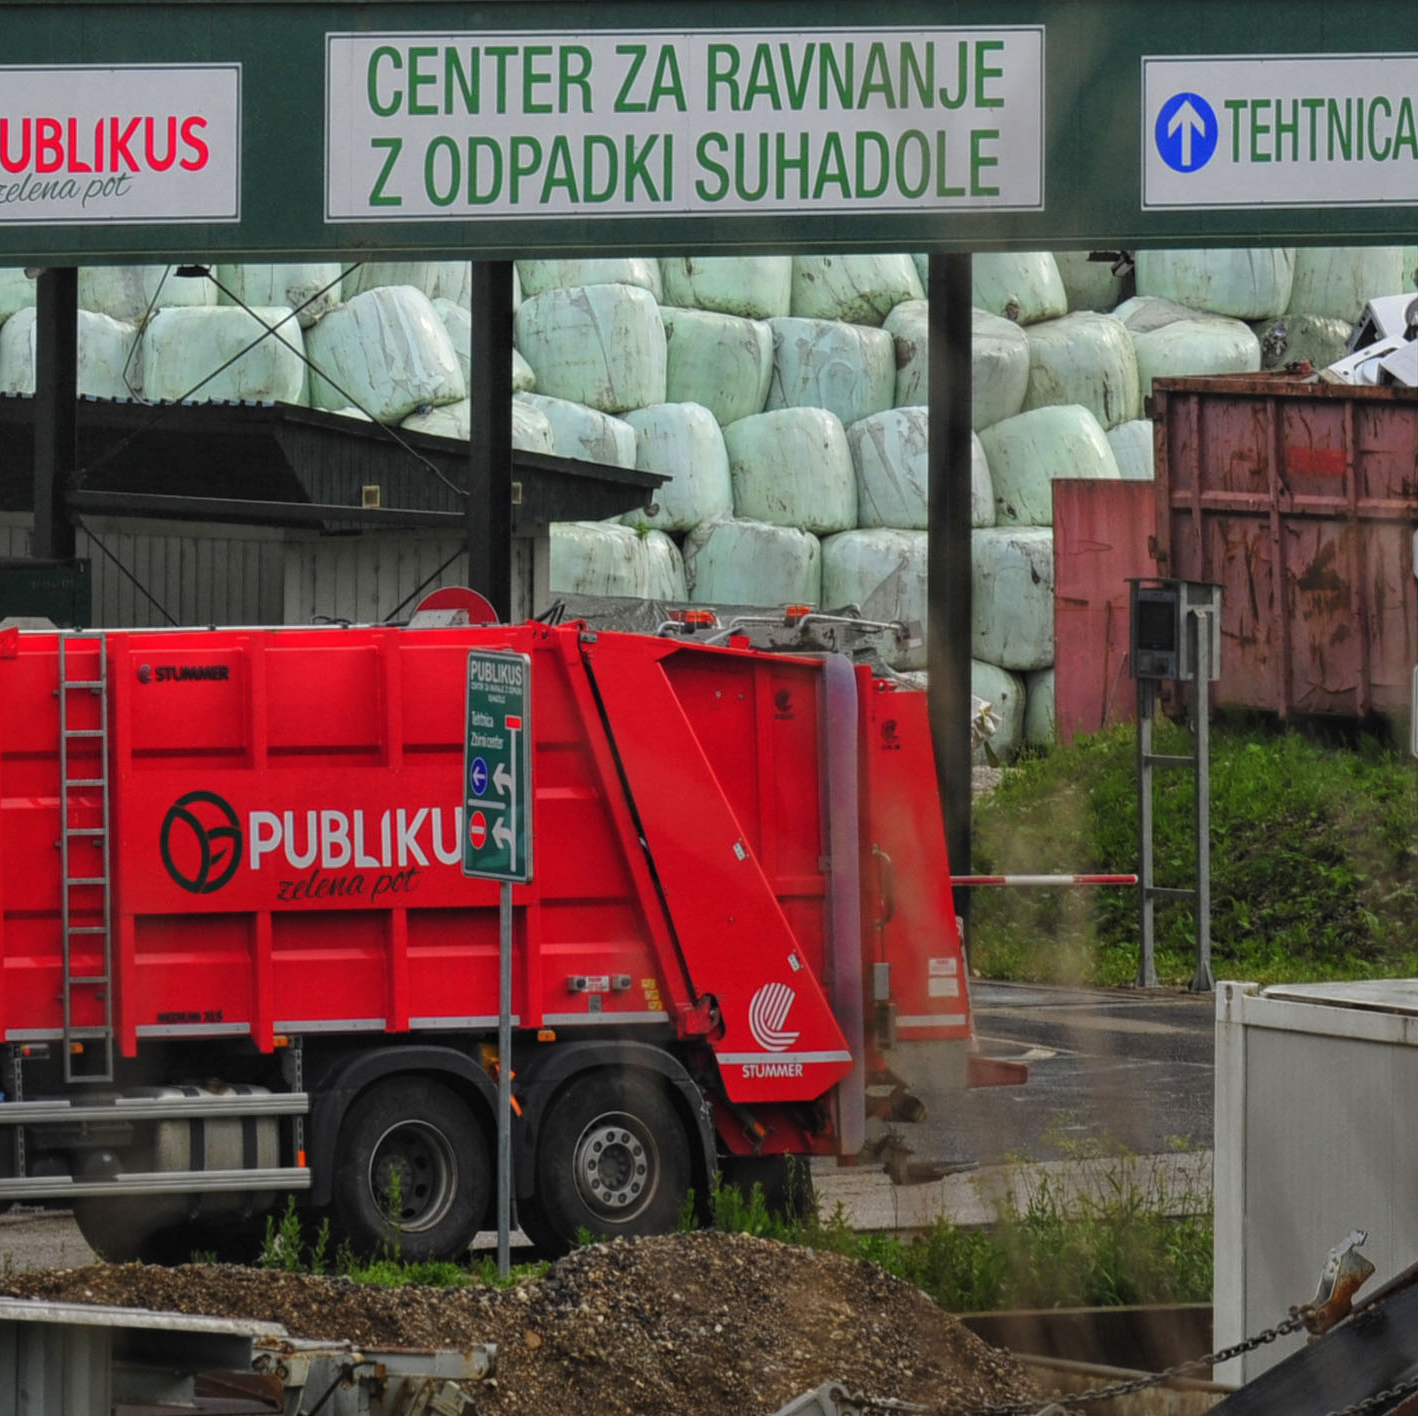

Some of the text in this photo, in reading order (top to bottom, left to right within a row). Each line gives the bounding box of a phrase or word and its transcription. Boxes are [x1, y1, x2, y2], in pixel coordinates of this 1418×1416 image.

[367, 40, 1005, 117] CENTER ZA RAVNANJE
[369, 129, 1000, 207] Z ODPADKI SUHADOLE
[82, 172, 133, 208] pot
[155, 665, 229, 682] STUMMER
[470, 660, 522, 685] PUBLIKUS
[249, 807, 463, 870] PUBLIKU
[277, 867, 421, 903] zelena pot
[742, 1063, 803, 1078] STUMMER
